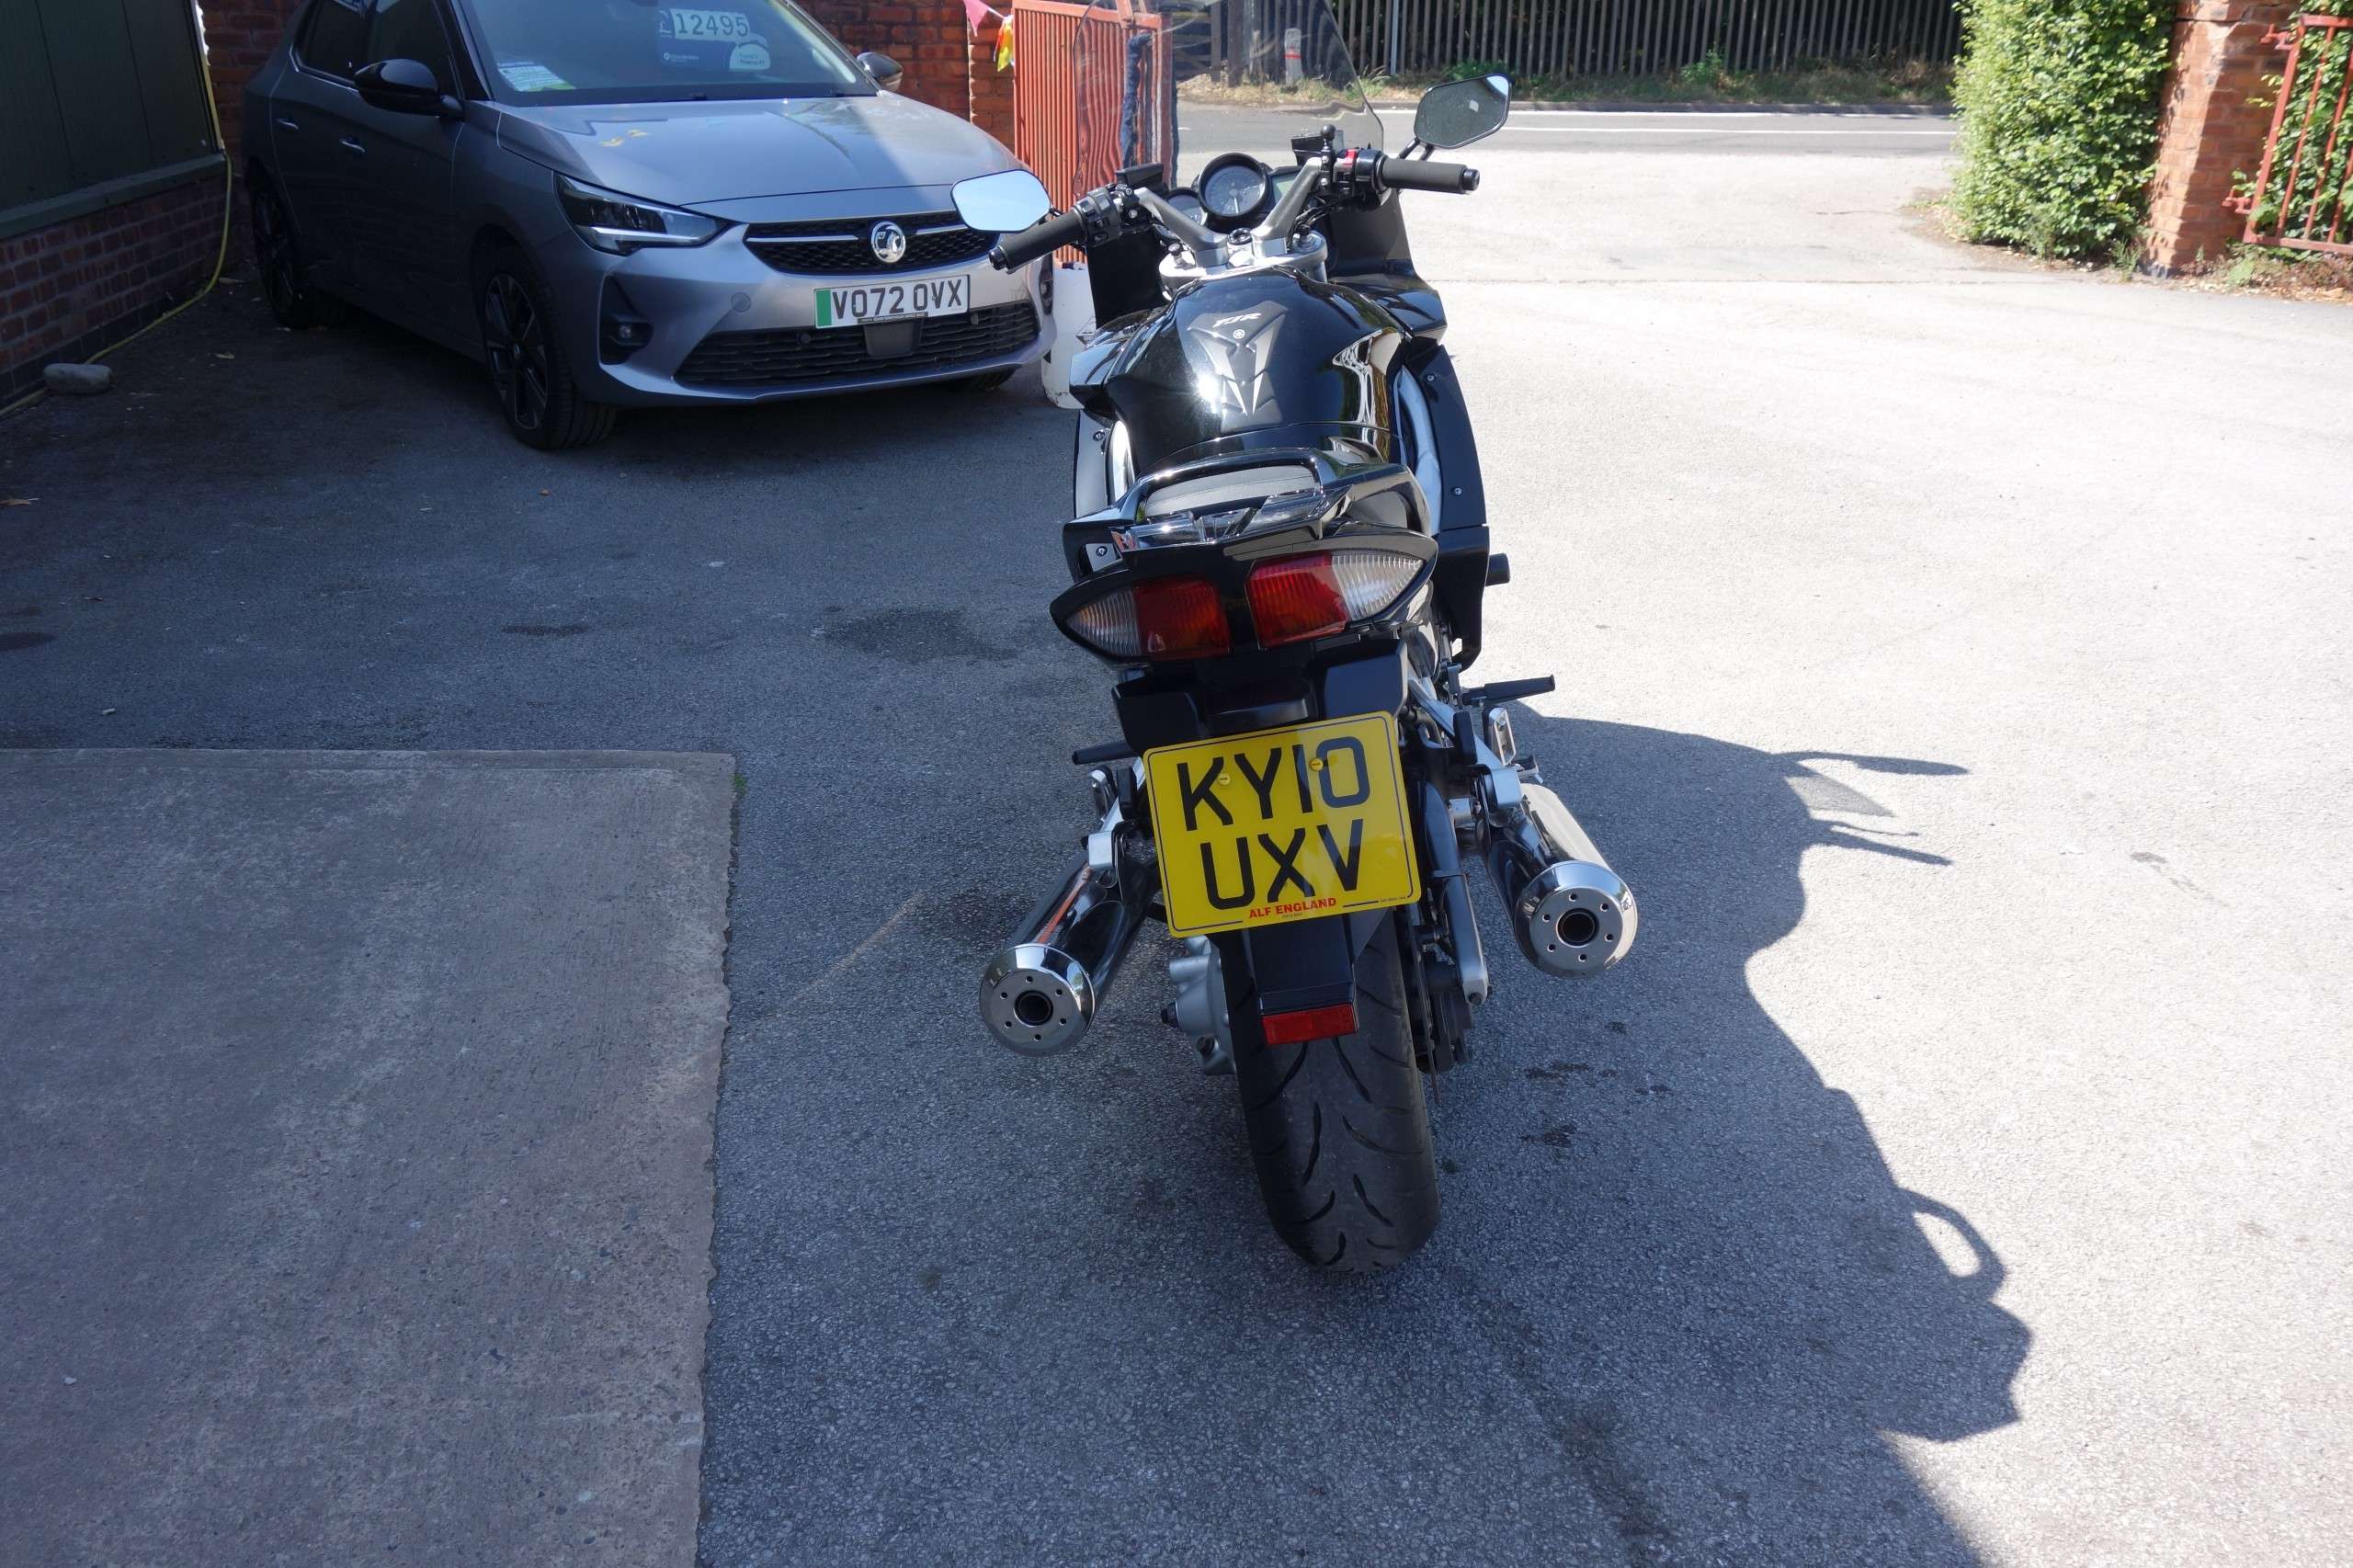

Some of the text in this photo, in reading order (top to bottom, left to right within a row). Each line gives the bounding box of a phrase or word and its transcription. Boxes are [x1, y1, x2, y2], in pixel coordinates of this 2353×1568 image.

[913, 278, 962, 312] OVX
[1176, 735, 1370, 832] KY10
[1199, 818, 1364, 910] UXV
[1249, 908, 1272, 919] ALF
[1275, 897, 1336, 915] ENGLAND
